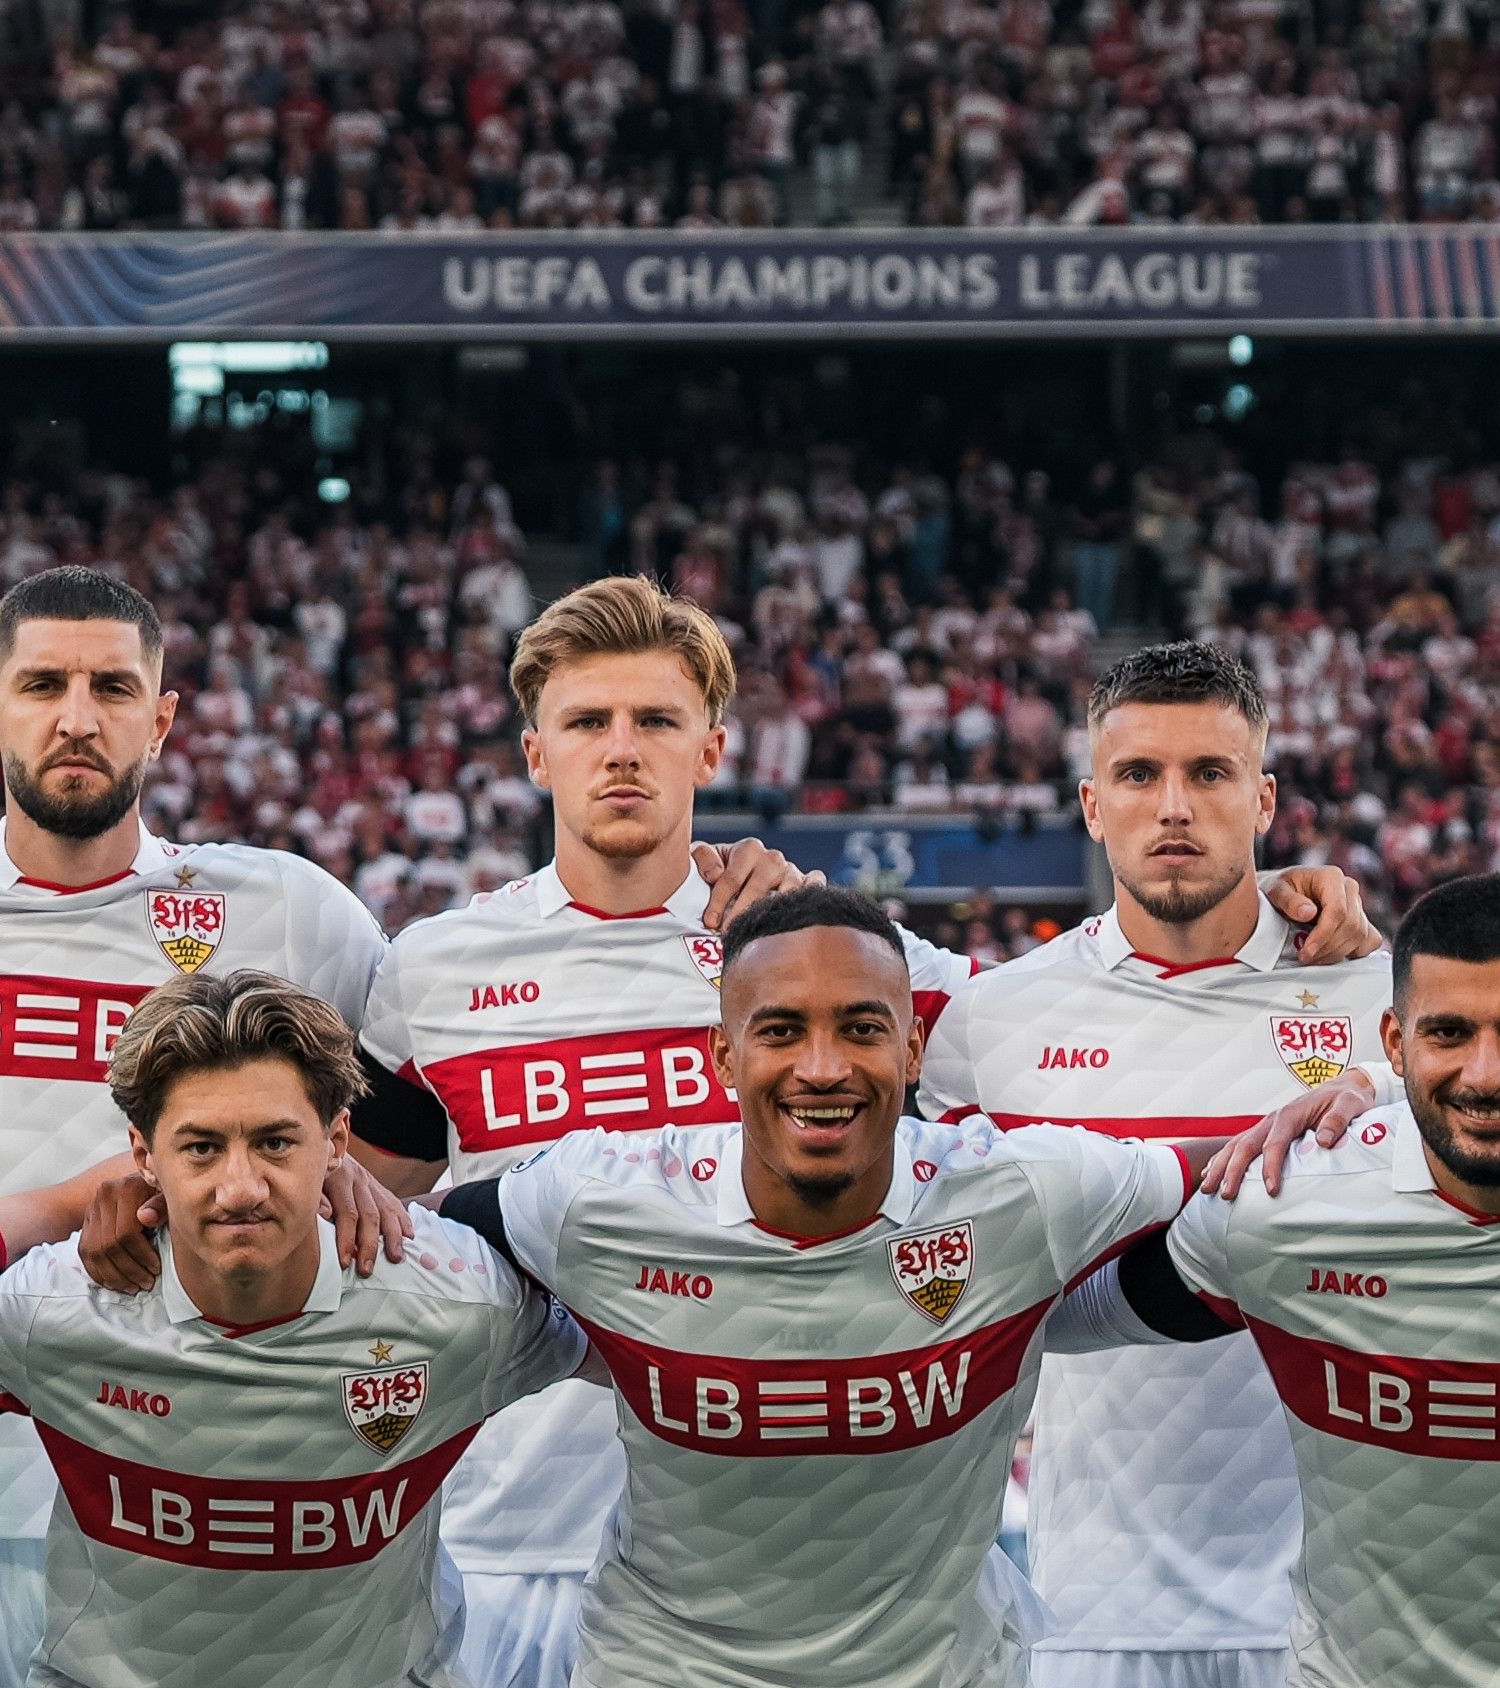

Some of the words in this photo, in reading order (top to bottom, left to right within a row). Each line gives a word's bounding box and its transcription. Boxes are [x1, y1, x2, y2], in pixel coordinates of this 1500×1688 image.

[444, 256, 611, 311] UEFA
[624, 254, 998, 311] CHAMPIONS
[1019, 253, 1262, 308] LEAGUE
[468, 981, 540, 1012] JAKO
[1037, 1046, 1111, 1070] JAKO
[635, 1266, 714, 1300] JAKO
[1306, 1268, 1388, 1299] JAKO
[96, 1381, 171, 1418] JAKO
